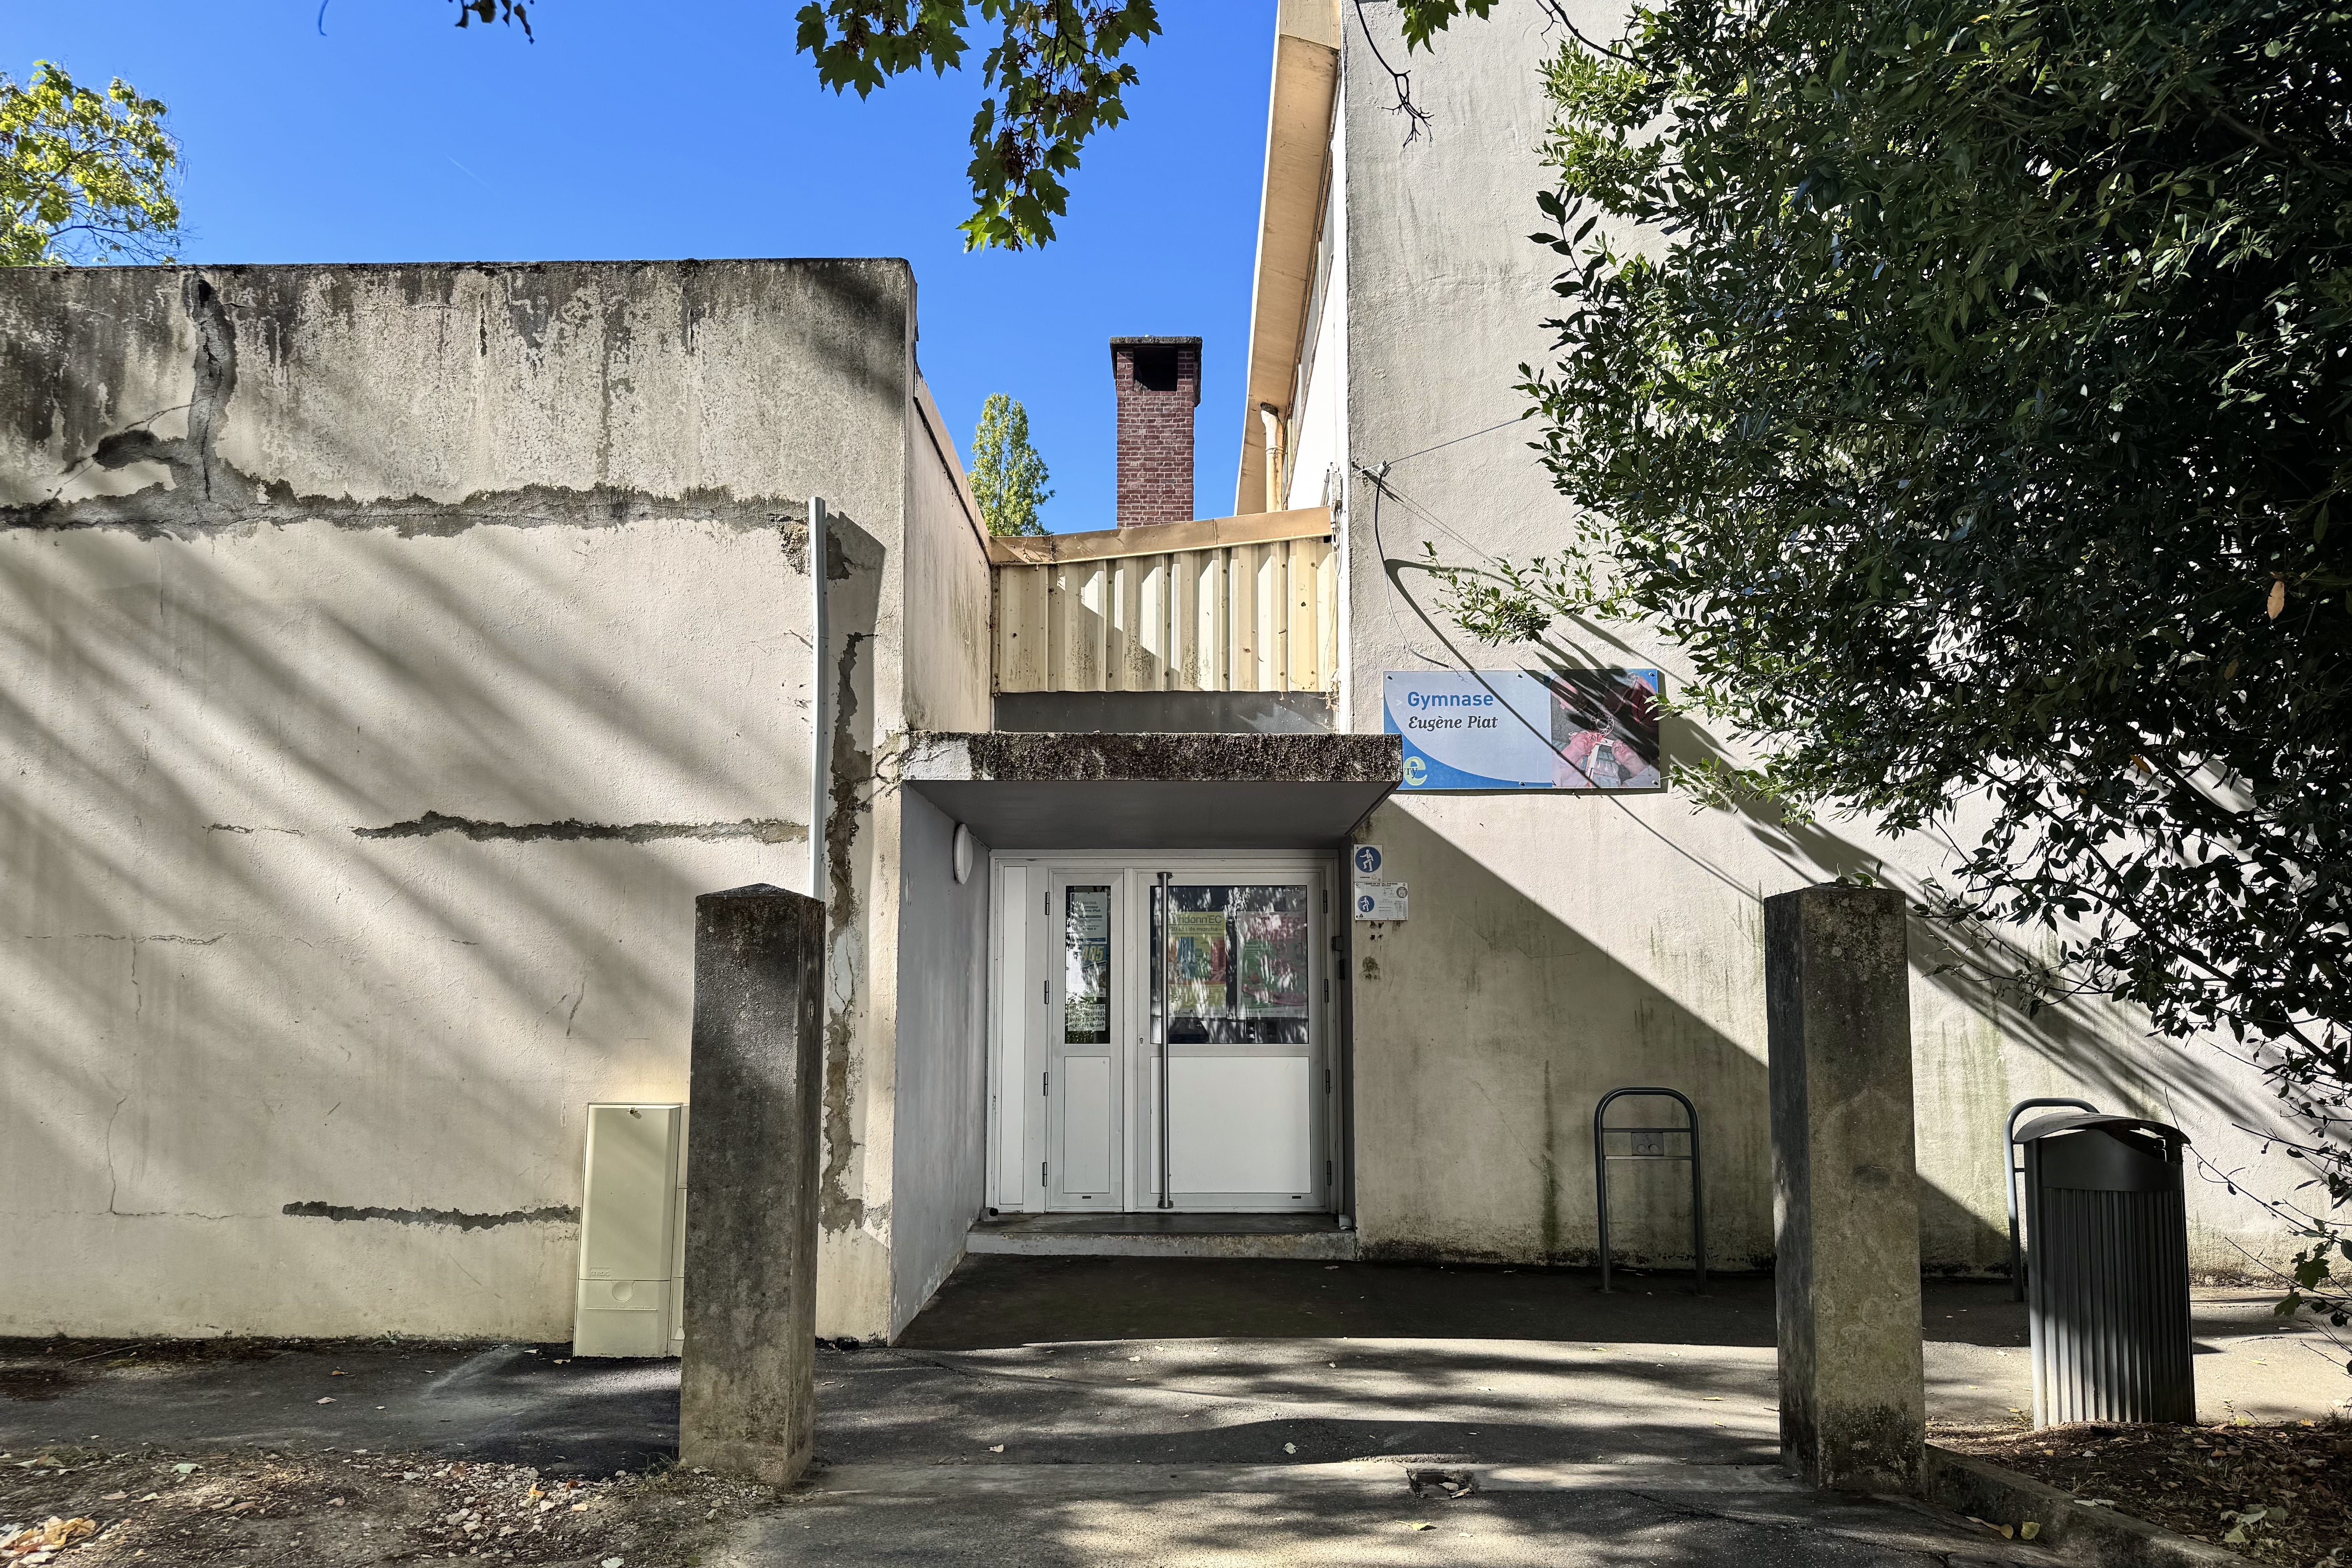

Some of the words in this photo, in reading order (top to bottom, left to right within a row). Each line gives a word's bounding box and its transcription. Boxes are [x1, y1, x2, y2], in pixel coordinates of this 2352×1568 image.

[1408, 691, 1494, 710] Gymnase
[1408, 716, 1462, 732] Eugène
[1468, 715, 1498, 729] Piat
